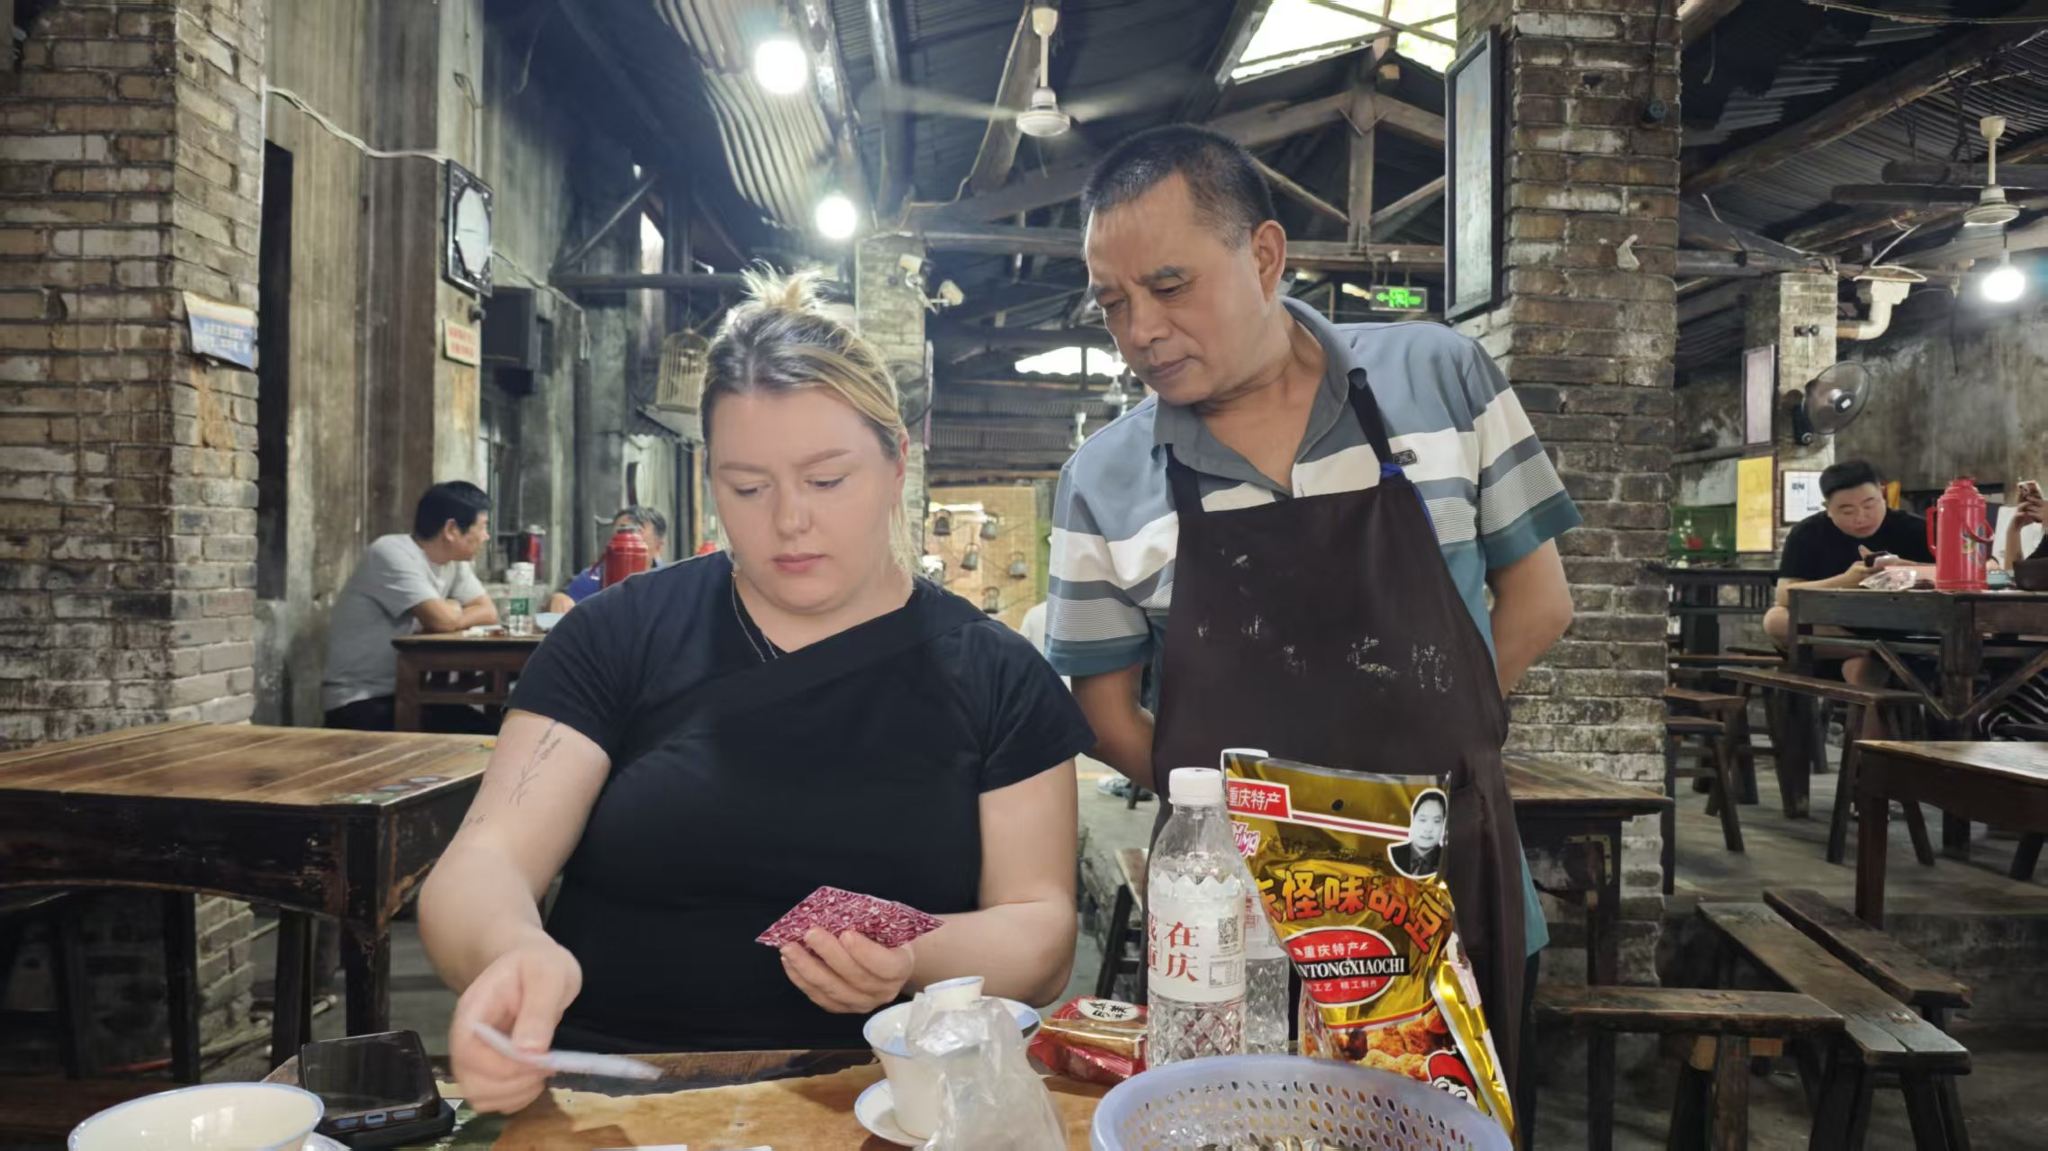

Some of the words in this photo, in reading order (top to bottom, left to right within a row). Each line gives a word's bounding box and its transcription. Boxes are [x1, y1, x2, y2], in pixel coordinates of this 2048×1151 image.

[1229, 786, 1282, 812] 重庆特产
[1303, 942, 1359, 959] 重庆特产
